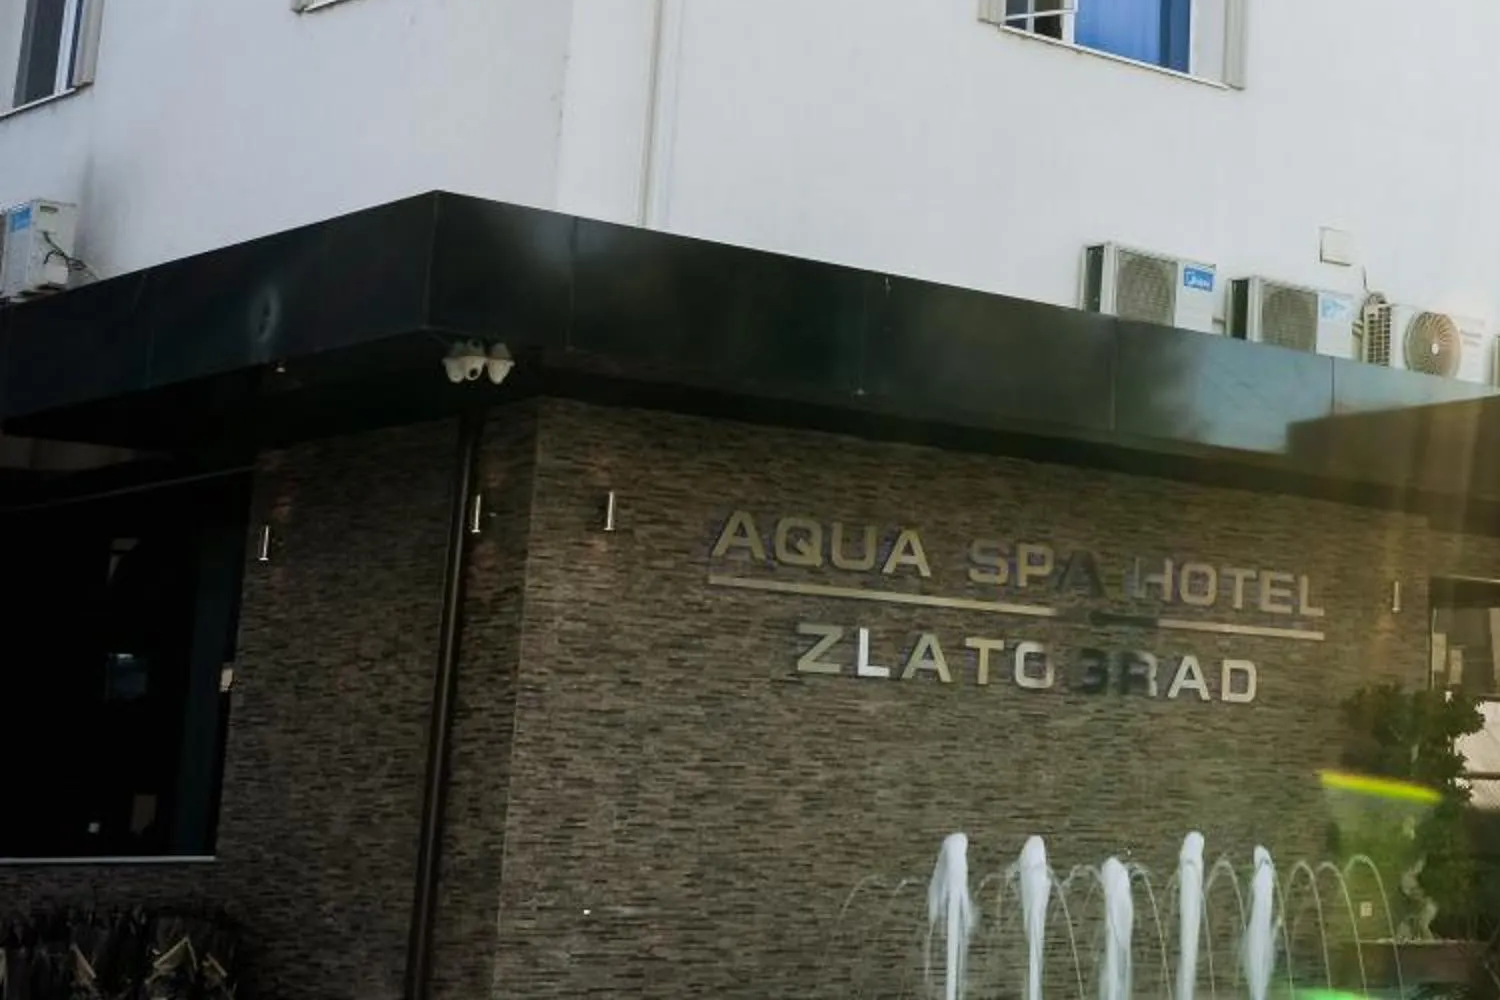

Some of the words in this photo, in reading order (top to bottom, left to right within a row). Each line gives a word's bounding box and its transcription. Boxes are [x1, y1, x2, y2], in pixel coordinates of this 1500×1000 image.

[711, 510, 932, 578] AQUA
[967, 538, 1106, 597] SPA
[1134, 556, 1326, 617] HOTEL
